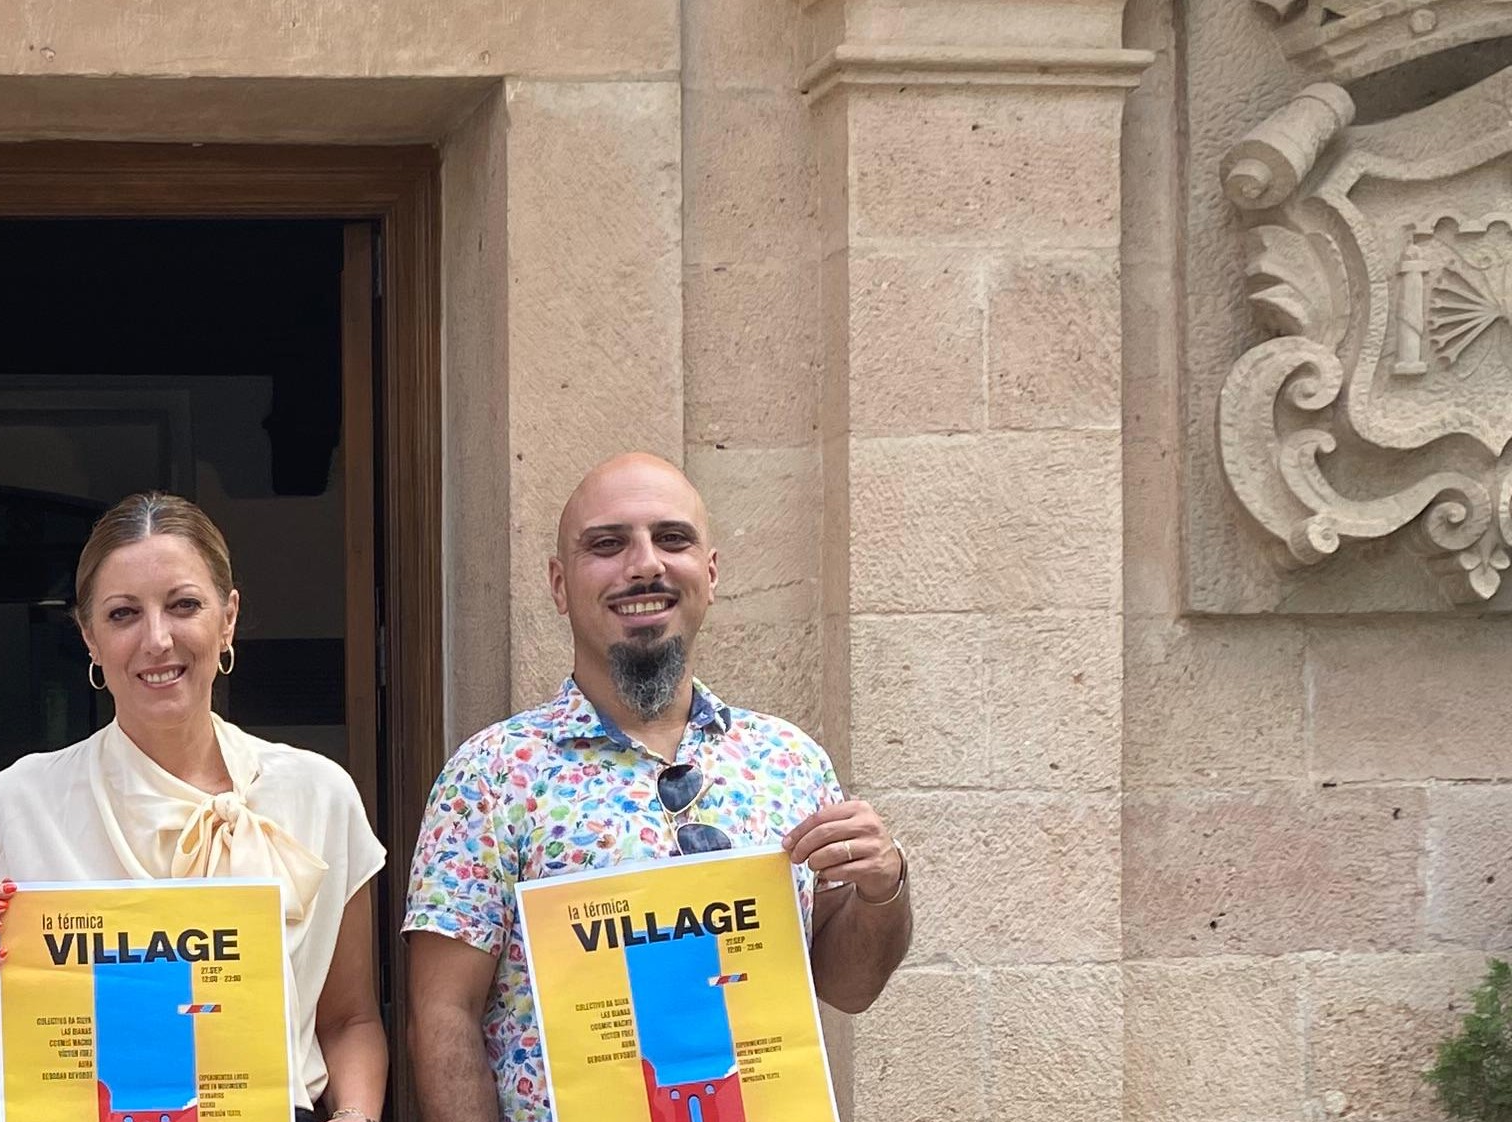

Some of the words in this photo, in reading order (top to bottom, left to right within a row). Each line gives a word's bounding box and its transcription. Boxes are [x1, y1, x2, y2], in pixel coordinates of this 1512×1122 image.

[42, 913, 53, 929] la
[57, 913, 104, 929] térmica
[568, 904, 580, 921] la
[583, 898, 630, 918] térmica
[571, 898, 760, 953] VILLAGE
[43, 929, 241, 966] VILLAGE
